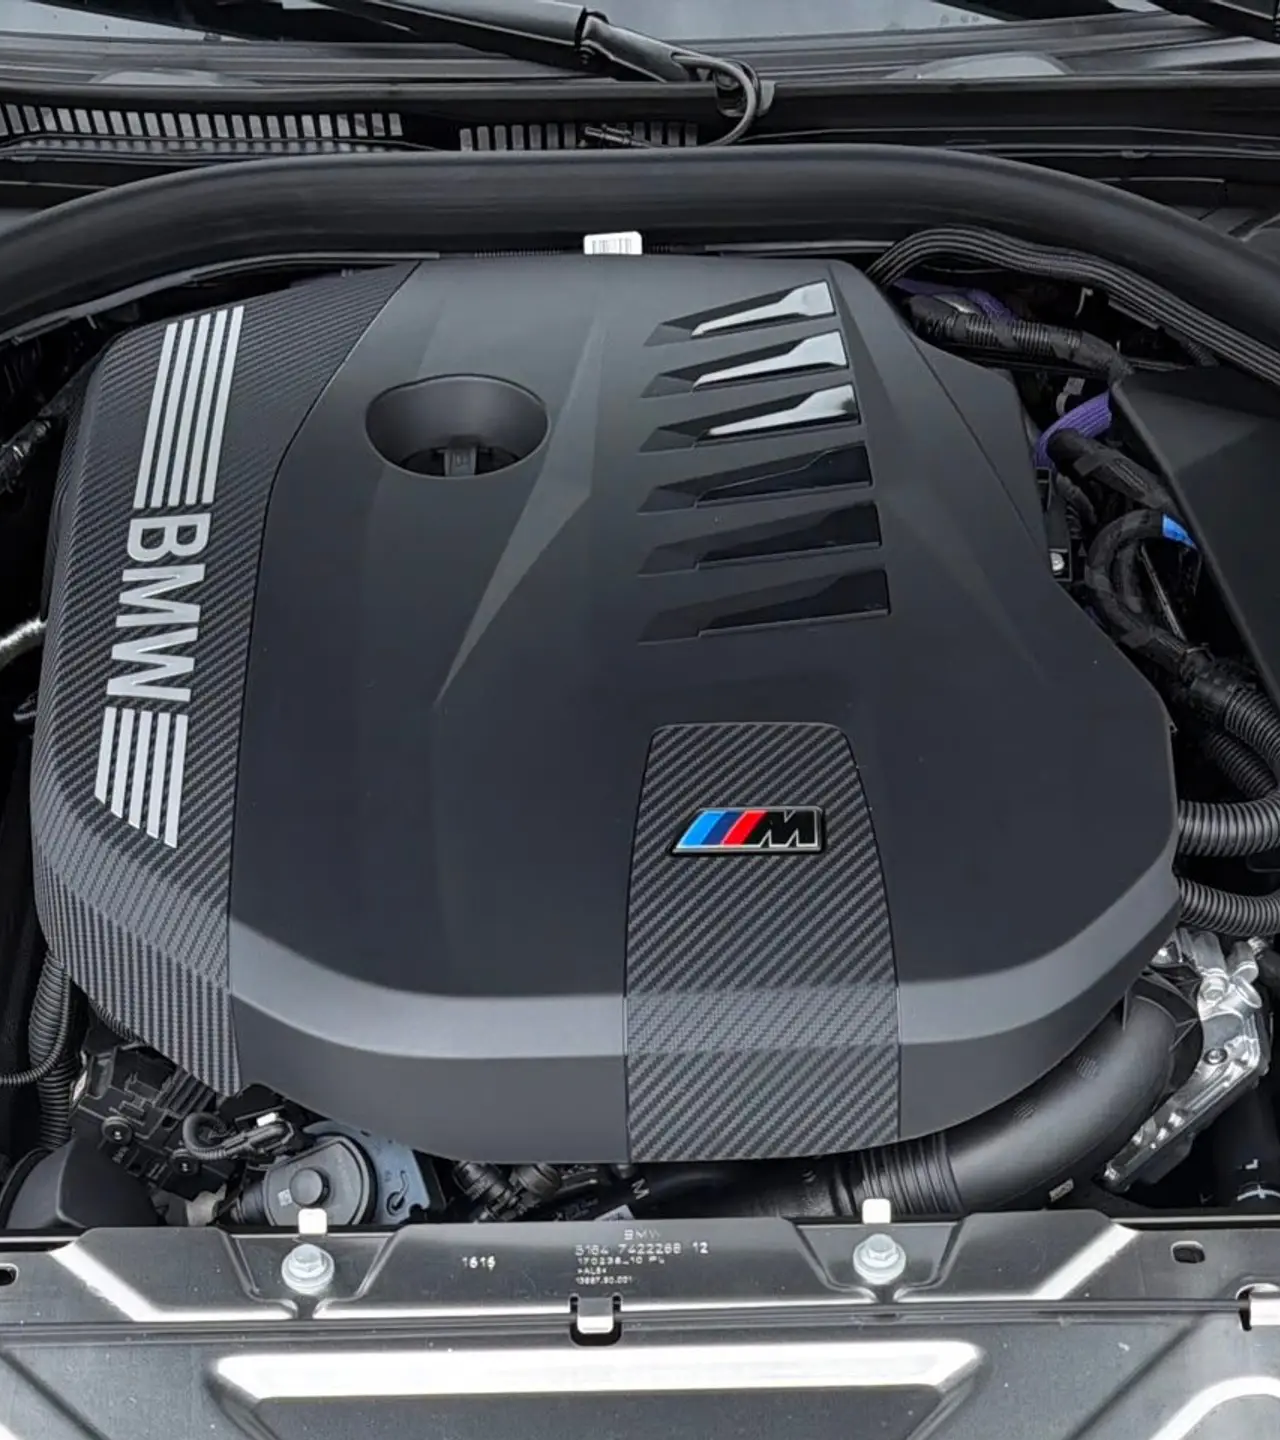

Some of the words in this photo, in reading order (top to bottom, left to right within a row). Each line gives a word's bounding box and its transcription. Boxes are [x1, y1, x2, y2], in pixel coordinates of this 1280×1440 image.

[107, 513, 211, 701] BMW
[747, 810, 818, 848] M
[624, 1229, 660, 1241] BMW
[692, 1241, 708, 1254] 12
